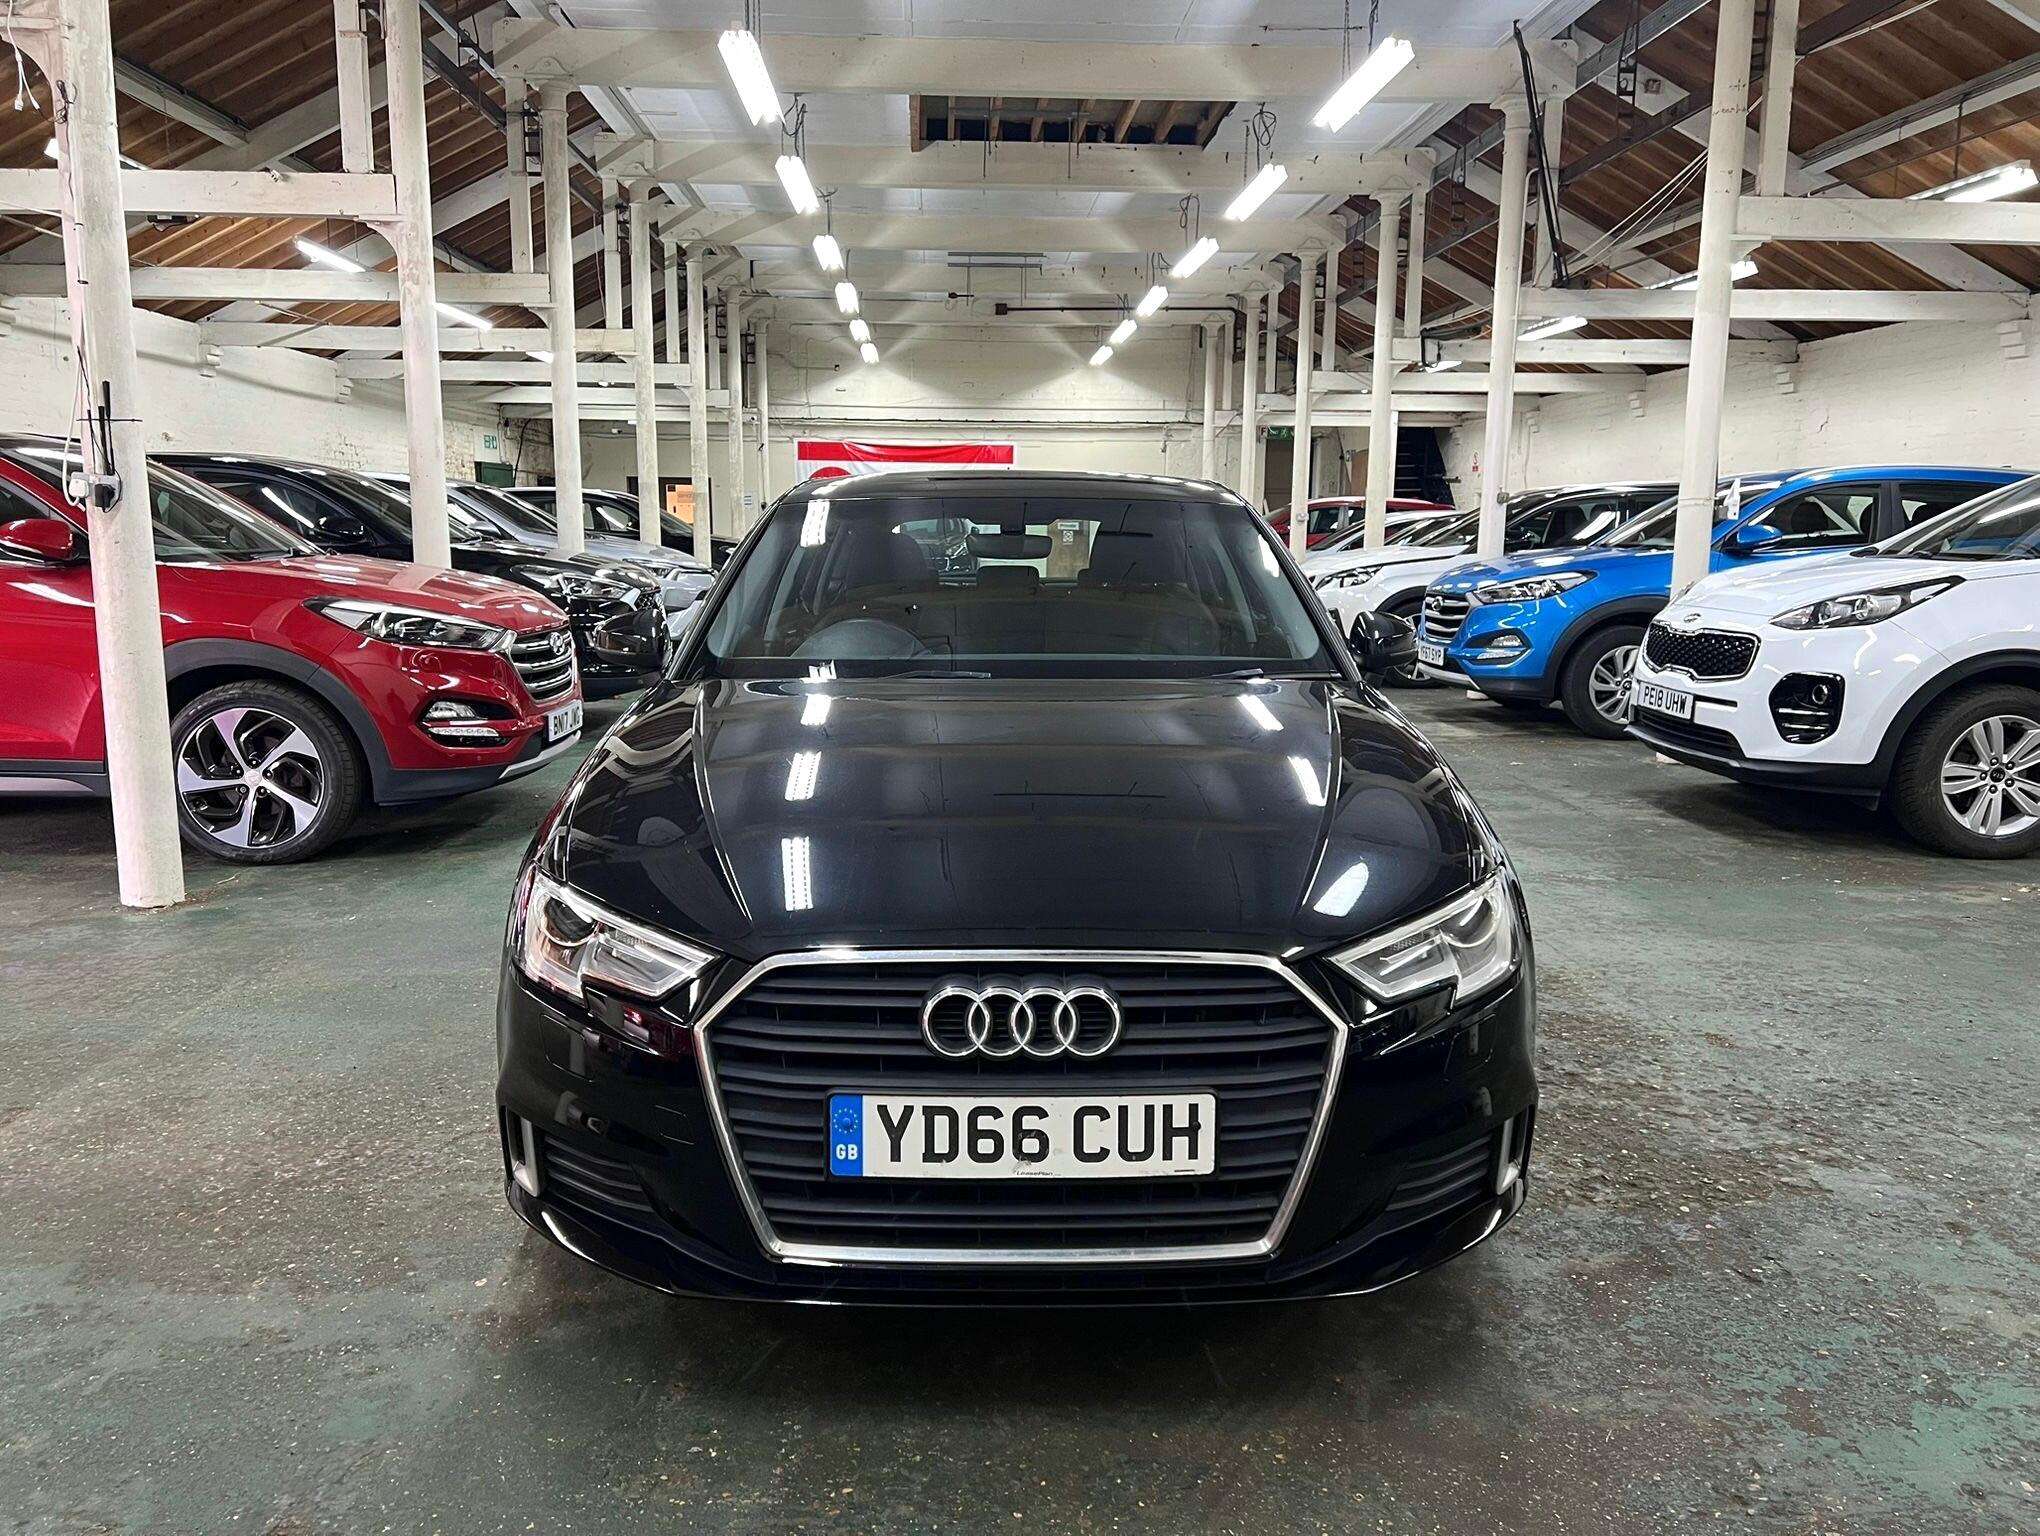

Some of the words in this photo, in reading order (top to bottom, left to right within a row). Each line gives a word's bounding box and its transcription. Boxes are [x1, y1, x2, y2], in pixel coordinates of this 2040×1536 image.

[1644, 686, 1664, 708] PE18
[1665, 691, 1687, 714] UHW
[877, 1104, 1049, 1163] YD66
[1073, 1103, 1200, 1163] CUH
[835, 1143, 858, 1160] GB
